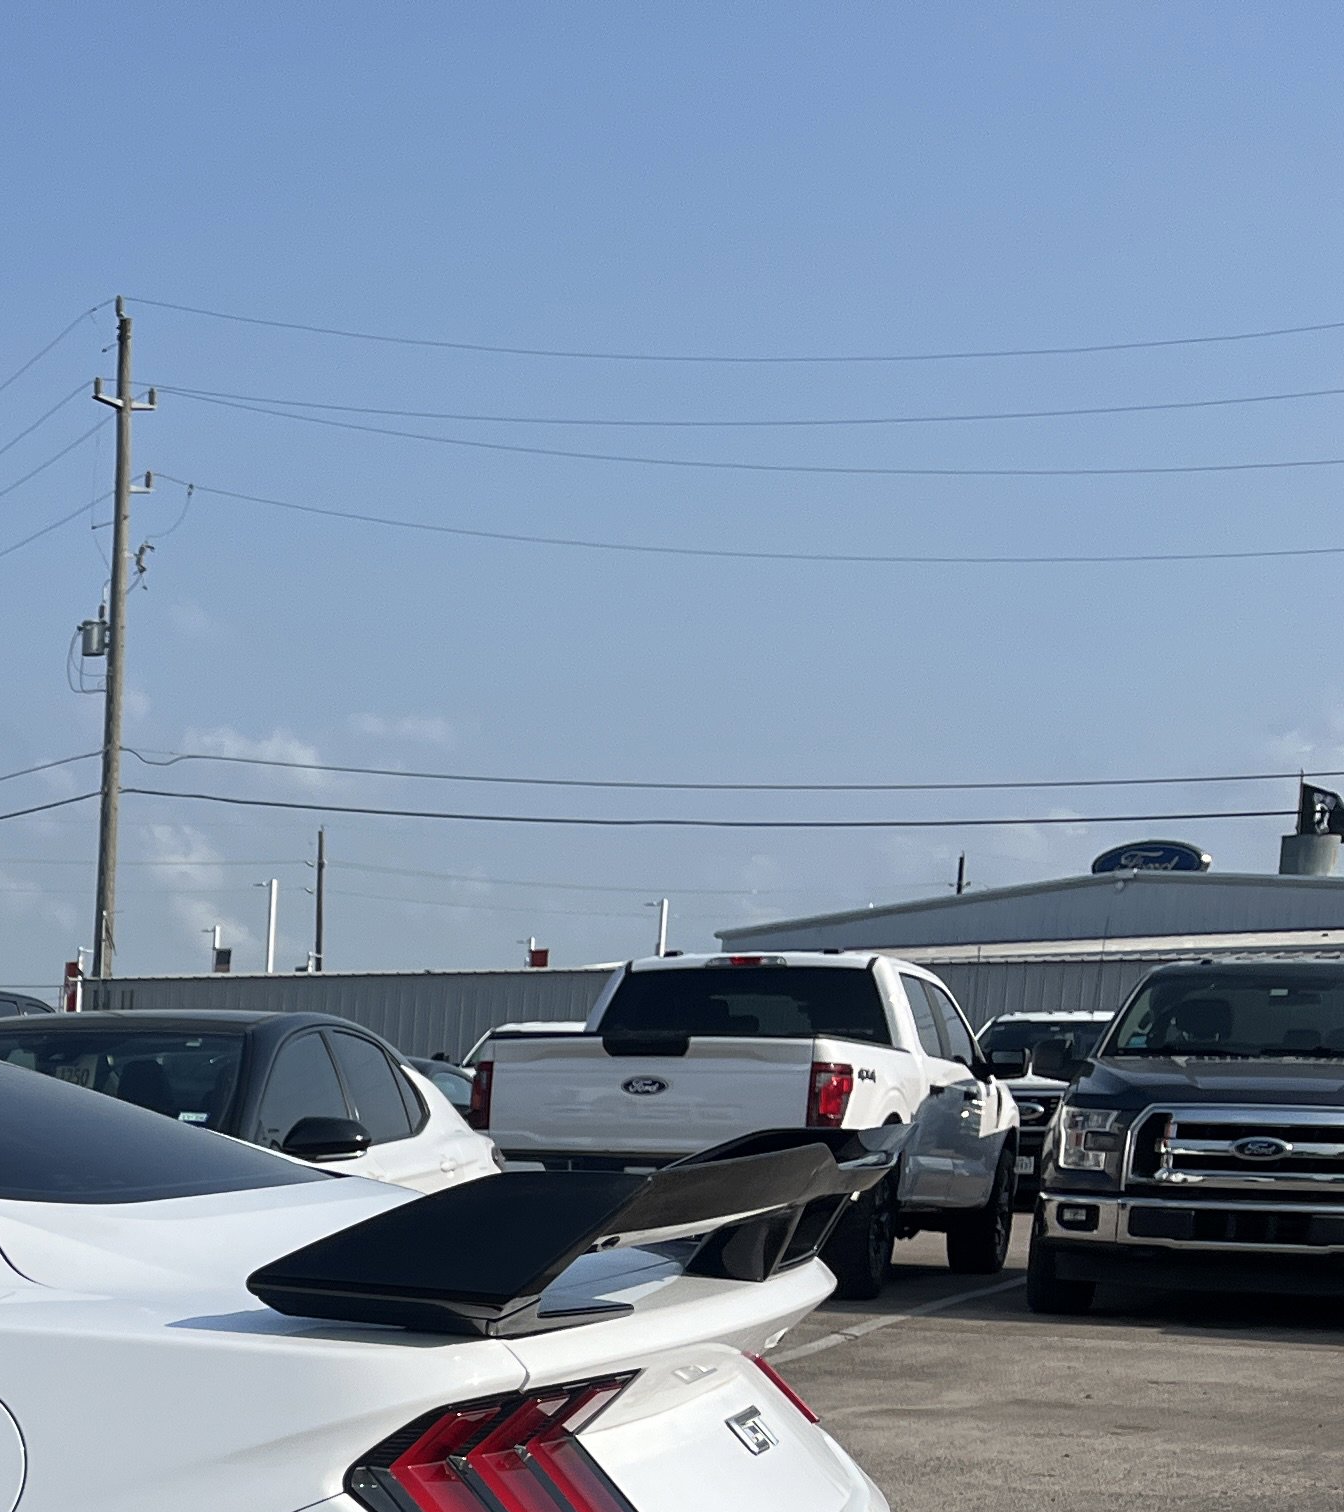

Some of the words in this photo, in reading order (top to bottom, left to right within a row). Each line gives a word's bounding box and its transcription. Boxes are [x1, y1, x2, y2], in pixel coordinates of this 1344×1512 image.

[628, 1079, 660, 1093] Ford
[1243, 1142, 1277, 1155] Ford
[724, 1404, 780, 1456] GT
